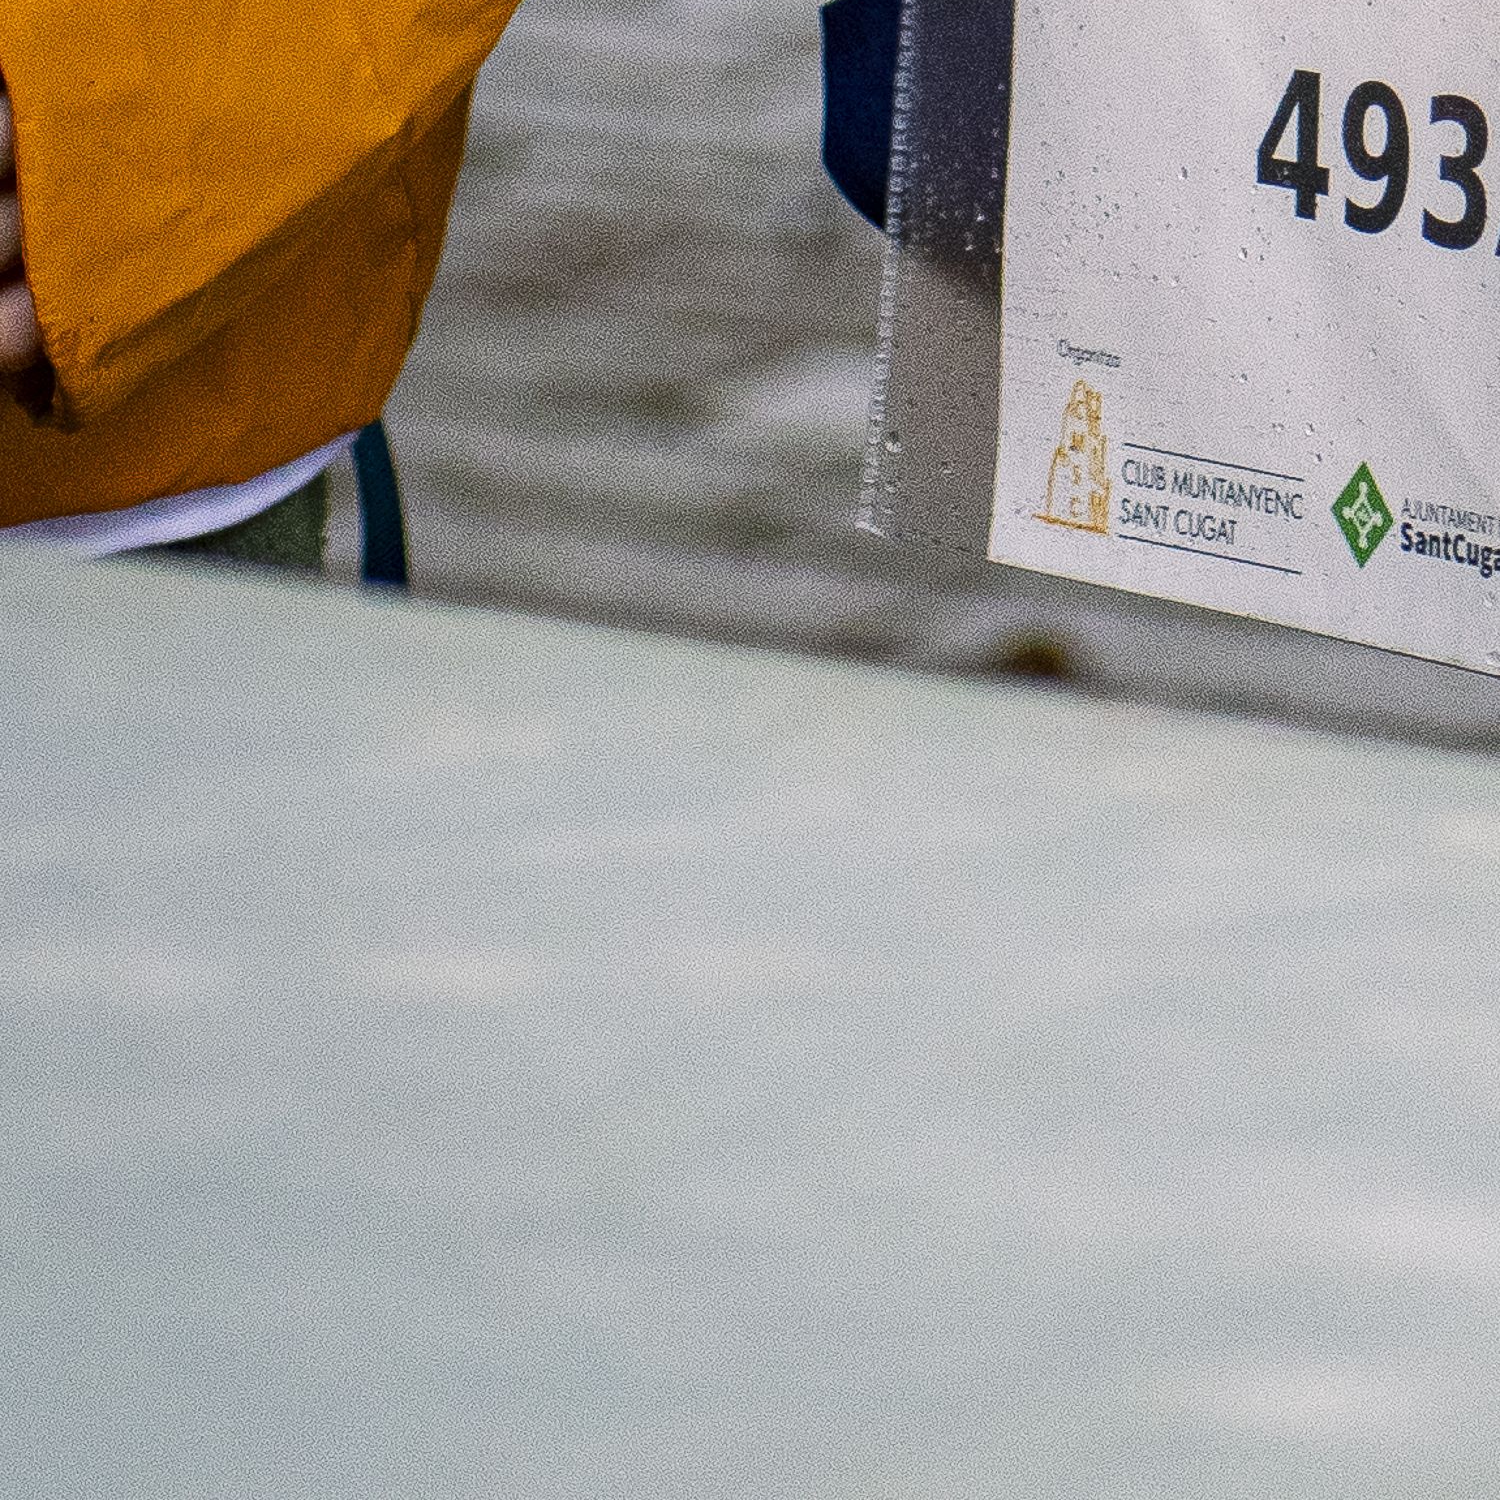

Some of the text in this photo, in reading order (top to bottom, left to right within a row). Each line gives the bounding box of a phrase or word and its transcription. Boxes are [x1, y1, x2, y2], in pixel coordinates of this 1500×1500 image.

[1120, 458, 1305, 521] CLUB MUNTANYENC
[1119, 496, 1238, 546] SANT CUGAT
[1400, 498, 1496, 536] AJUNTAMENT
